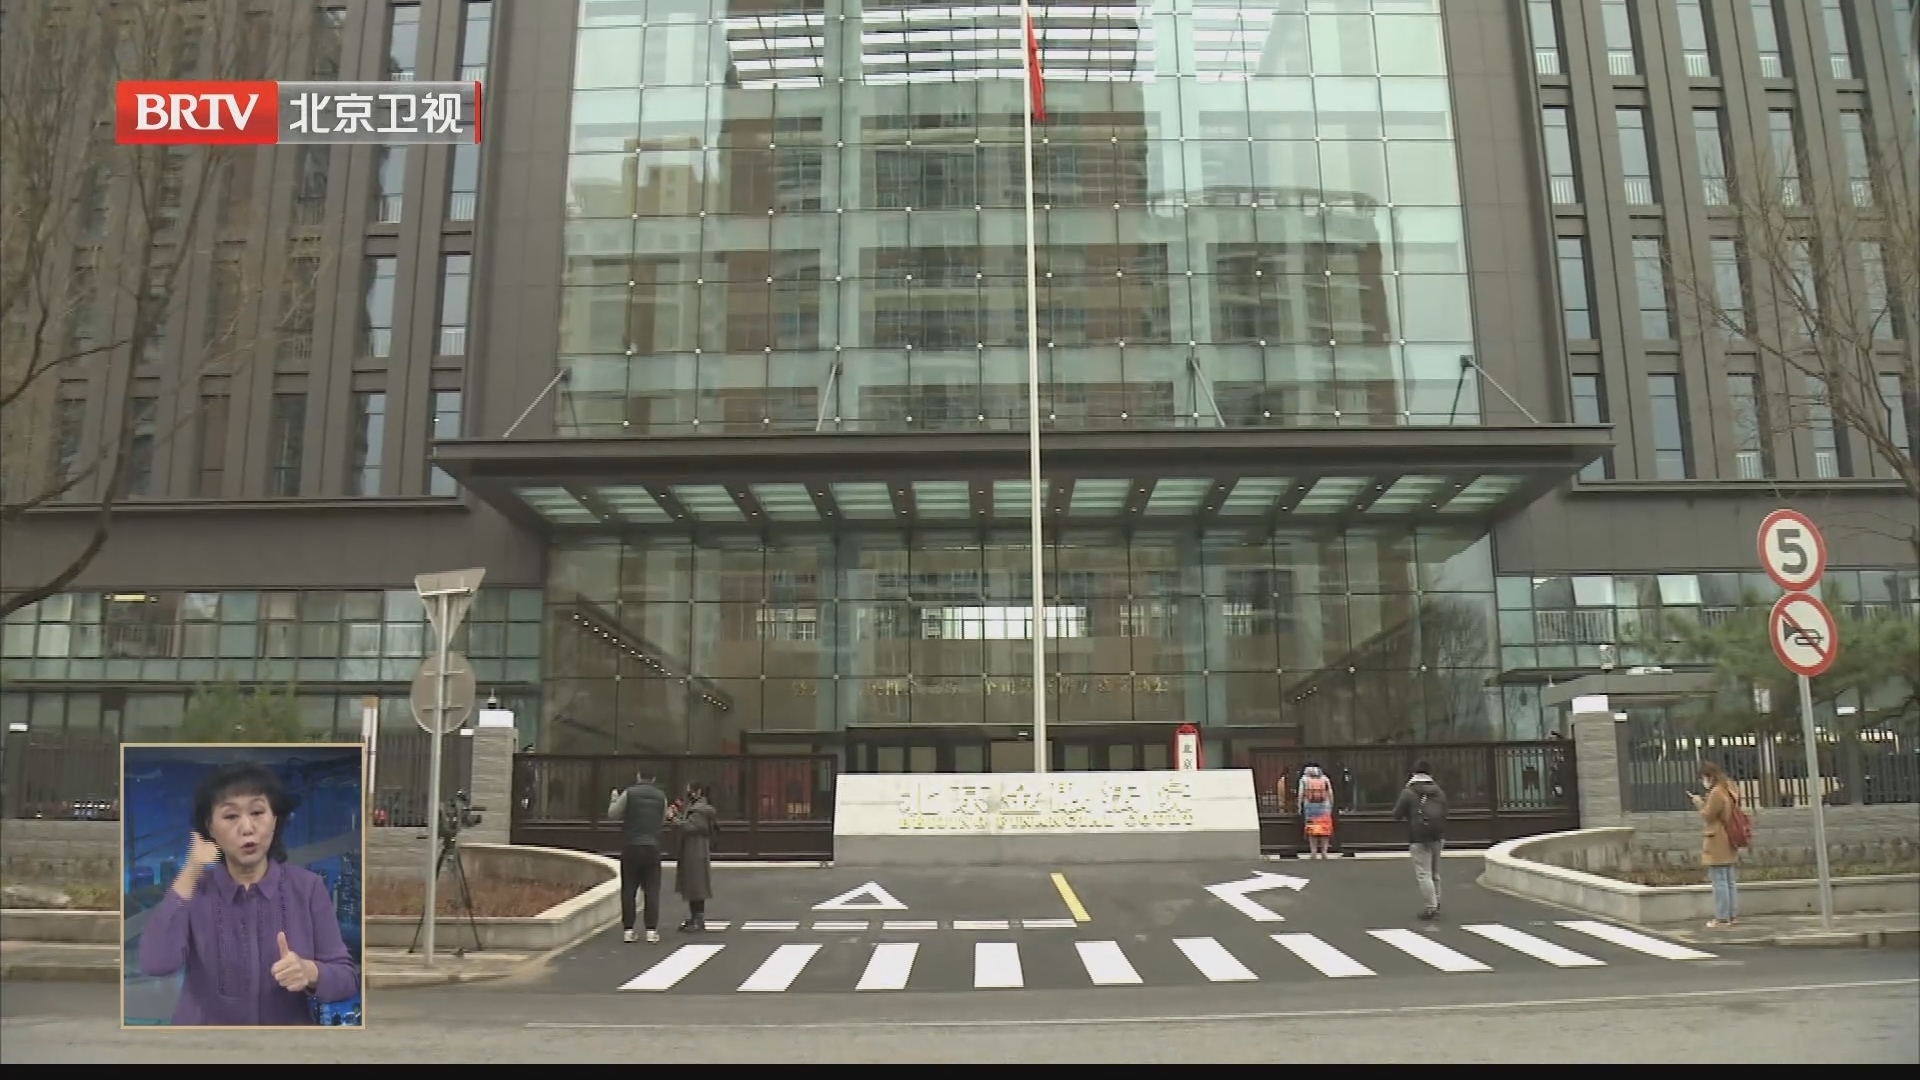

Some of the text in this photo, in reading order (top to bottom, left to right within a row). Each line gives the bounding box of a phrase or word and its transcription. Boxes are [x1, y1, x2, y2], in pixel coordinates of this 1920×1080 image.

[1776, 529, 1808, 574] 5
[898, 780, 1193, 815] 北京金融法院
